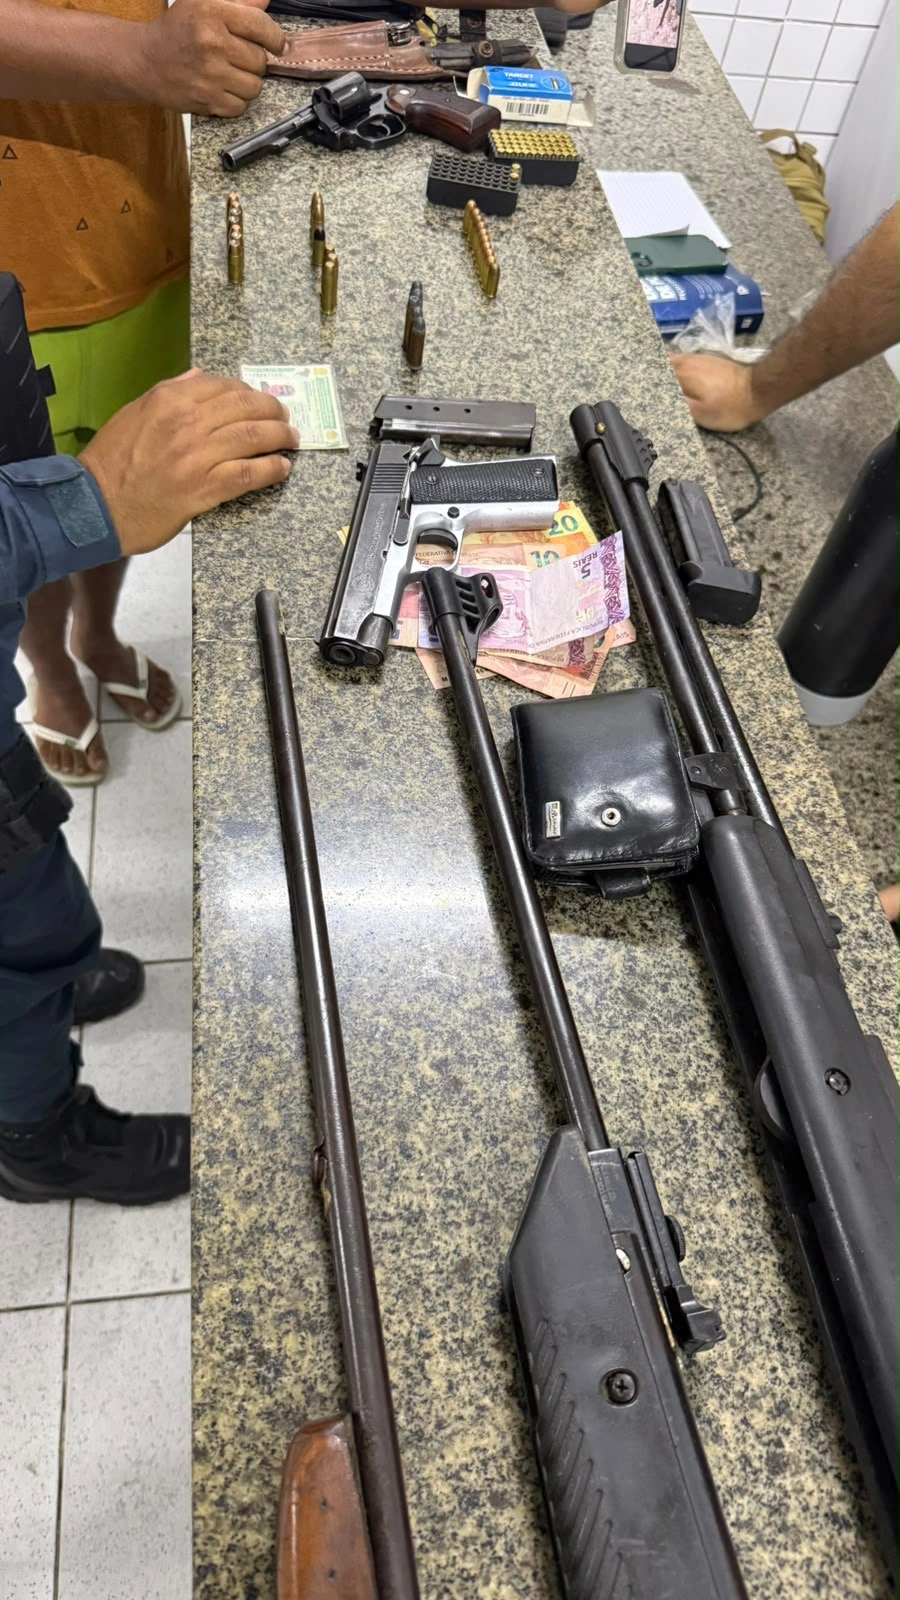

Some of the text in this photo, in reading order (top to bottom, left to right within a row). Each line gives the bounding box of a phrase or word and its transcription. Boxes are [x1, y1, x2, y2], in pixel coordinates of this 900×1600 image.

[549, 515, 579, 536] 20
[416, 550, 451, 558] FEDERATIVA
[531, 550, 560, 568] 10
[573, 551, 598, 569] REAIS
[581, 562, 591, 579] 5
[535, 628, 570, 645] FEDERATIVA
